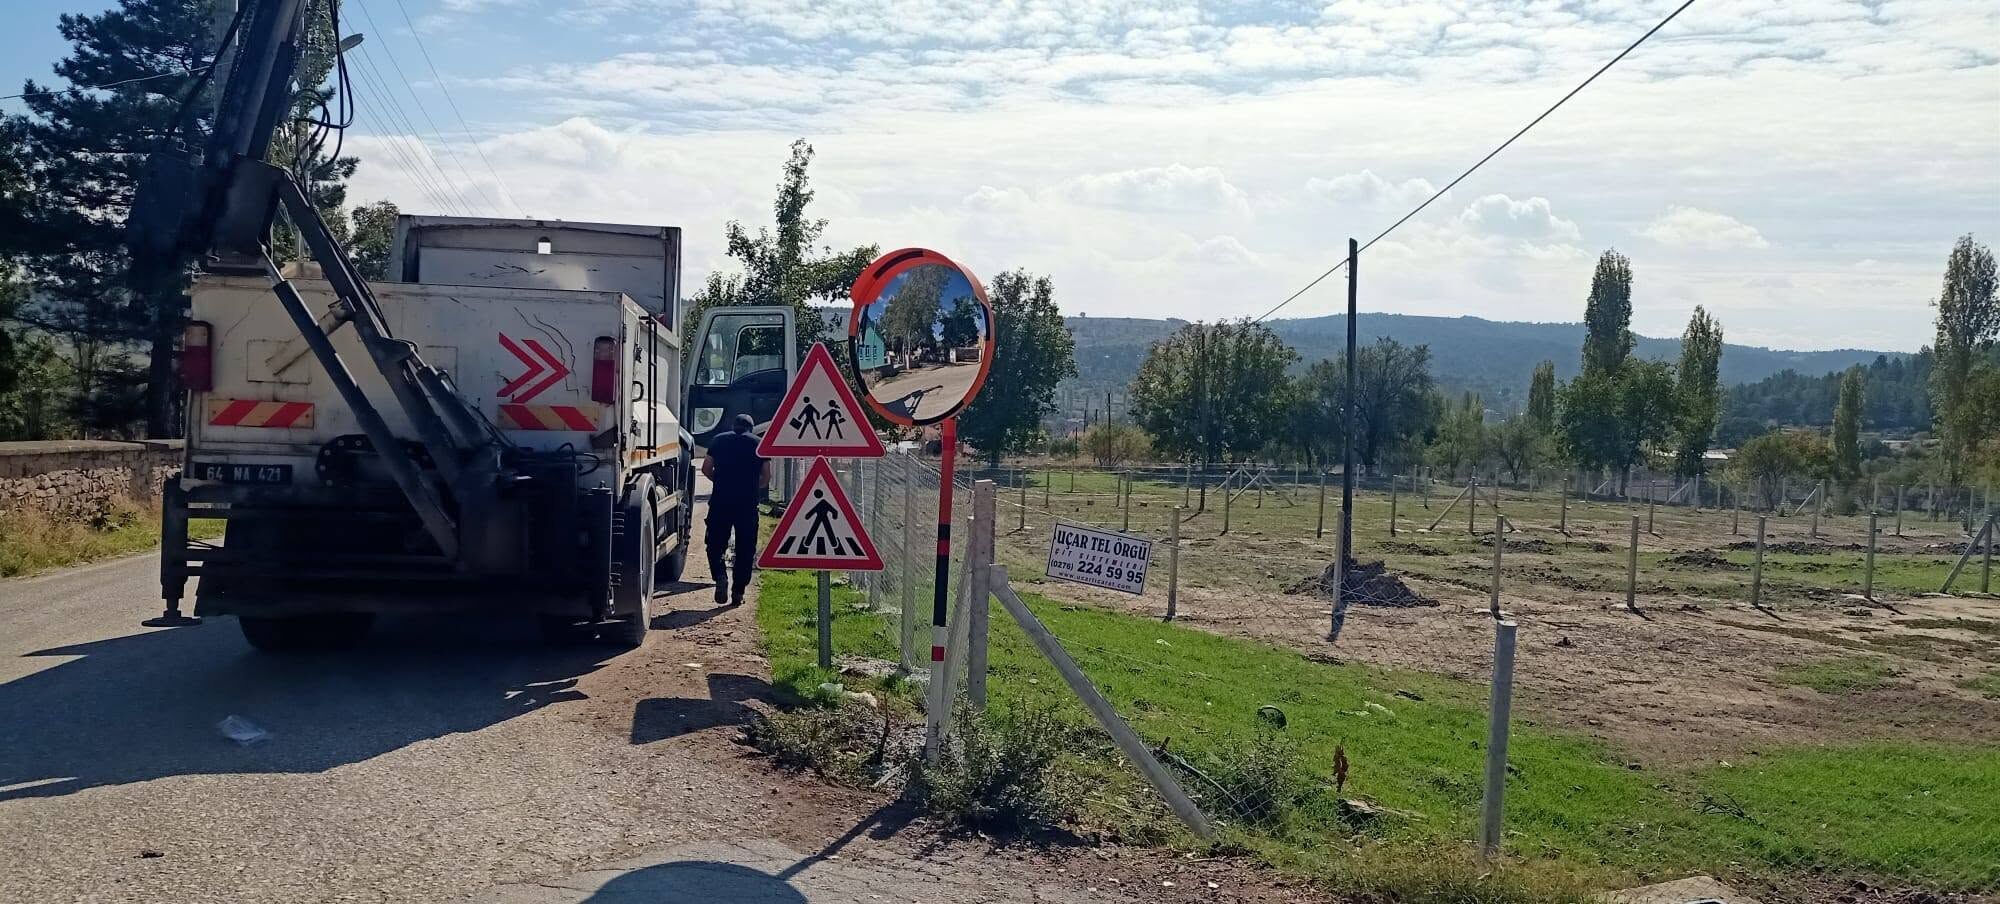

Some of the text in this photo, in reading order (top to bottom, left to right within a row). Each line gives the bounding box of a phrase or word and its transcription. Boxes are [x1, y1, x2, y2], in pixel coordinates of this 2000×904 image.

[207, 466, 223, 481] 64
[1057, 530, 1147, 560] UÇAR TEL ÖRGÜ
[1051, 559, 1143, 583] (0276) 224 59 95
